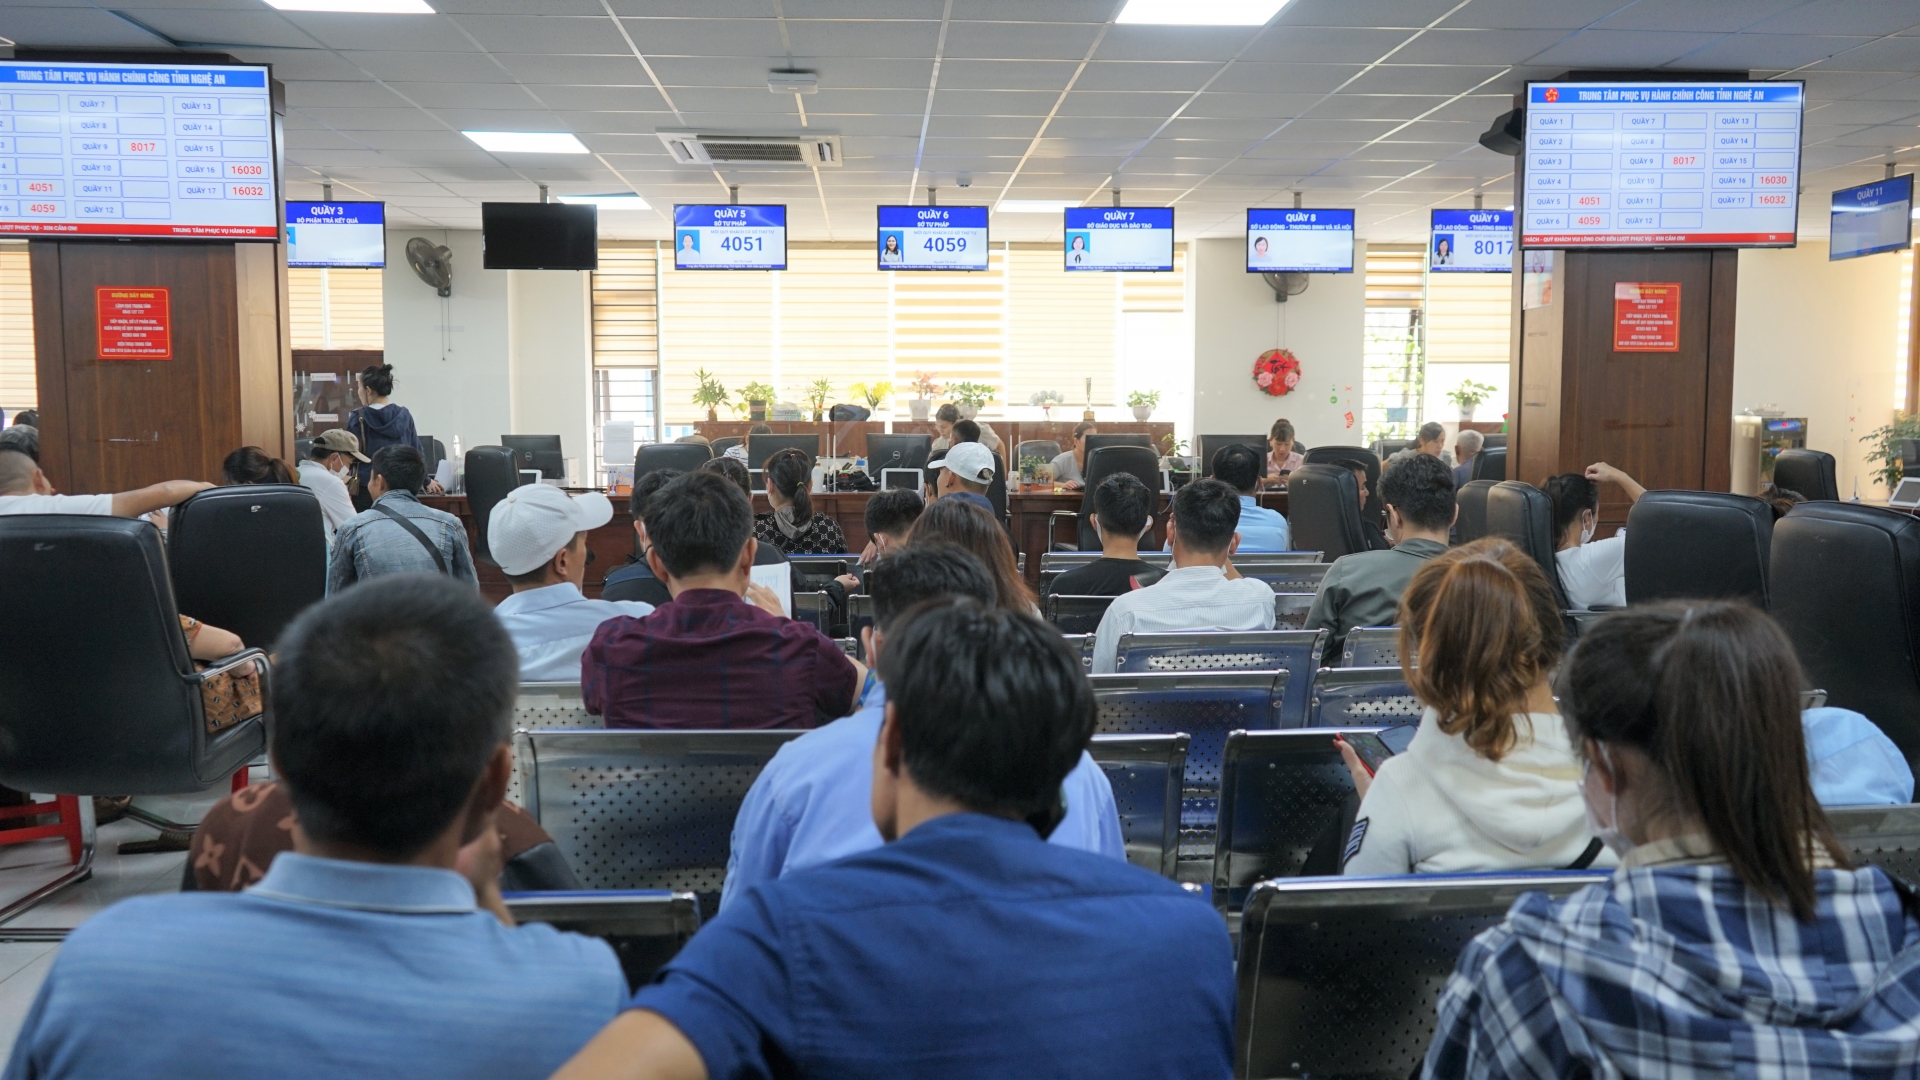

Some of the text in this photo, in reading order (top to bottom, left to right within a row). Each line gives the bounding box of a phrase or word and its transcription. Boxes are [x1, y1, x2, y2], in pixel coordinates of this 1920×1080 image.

[16, 69, 226, 86] TRUNG TÂM PHỤC VỤ HÀNH CHÍNH CÔNG TỈNH NGHỆ AN
[1579, 88, 1764, 102] TRUNG TÂM PHỤC VỤ HÀNH CHÍNH CÔNG TỈNH NGHỆ AN
[182, 102, 200, 110] QUẦY
[81, 121, 100, 129] QUẦY
[183, 123, 201, 131] QUẦY
[82, 142, 101, 150] QUẦY
[130, 143, 155, 151] 8017
[1673, 157, 1695, 165] 8017
[231, 166, 262, 174] 16030
[1760, 176, 1787, 184] 16030
[29, 183, 53, 192] 4051
[83, 184, 101, 192] QUẦY
[187, 186, 205, 194] QUẦY
[233, 187, 263, 195] 16032
[1876, 187, 1883, 196] 11
[1579, 197, 1600, 205] 4051
[30, 204, 55, 212] 4059
[311, 205, 335, 216] QUẦY
[714, 208, 738, 219] QUẦY
[918, 209, 941, 219] QUẦY
[1104, 210, 1127, 221] QUẦY
[1286, 212, 1309, 222] QUẦY
[1470, 213, 1493, 223] QUẦY
[721, 237, 762, 251] 4051
[924, 238, 967, 252] 4059
[1475, 241, 1513, 254] 8017
